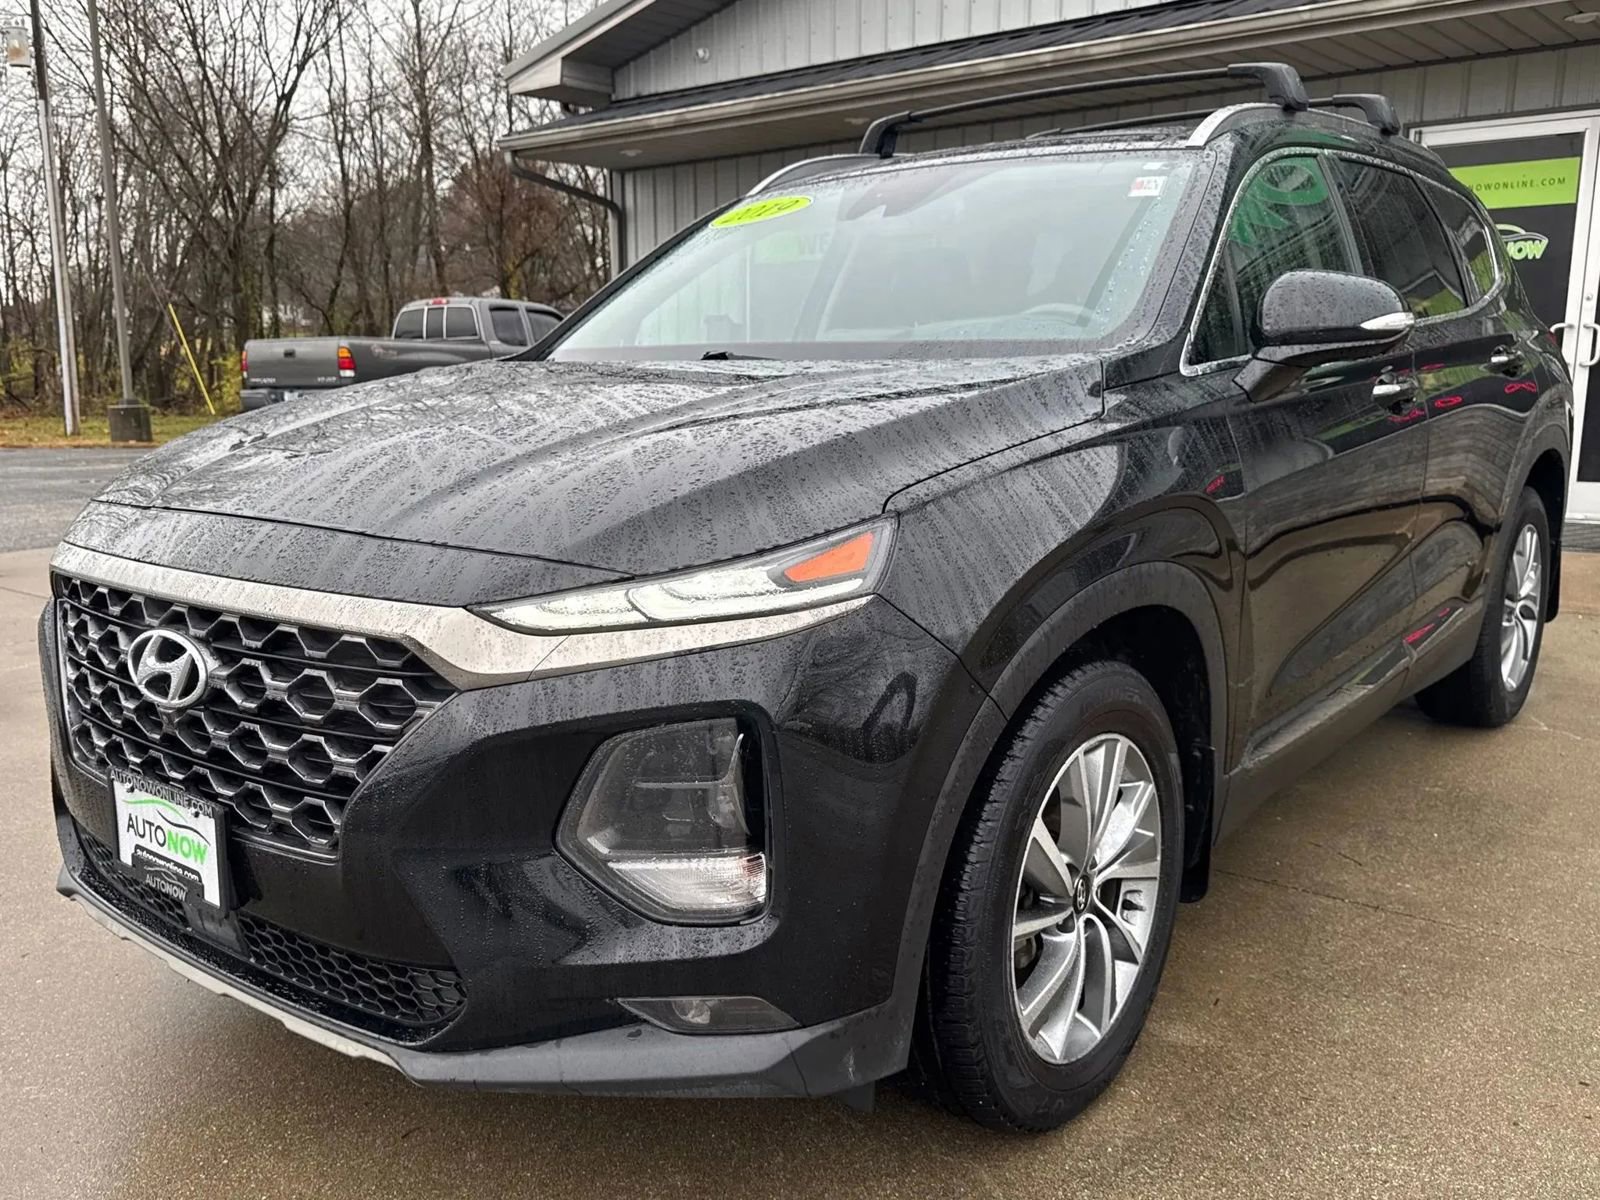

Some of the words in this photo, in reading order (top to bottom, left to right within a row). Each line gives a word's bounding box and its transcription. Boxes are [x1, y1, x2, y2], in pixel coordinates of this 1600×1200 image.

[110, 769, 213, 818] AUTONOWONLINE.COM
[127, 813, 209, 865] AUTONOW
[145, 874, 188, 902] AUTONOW
